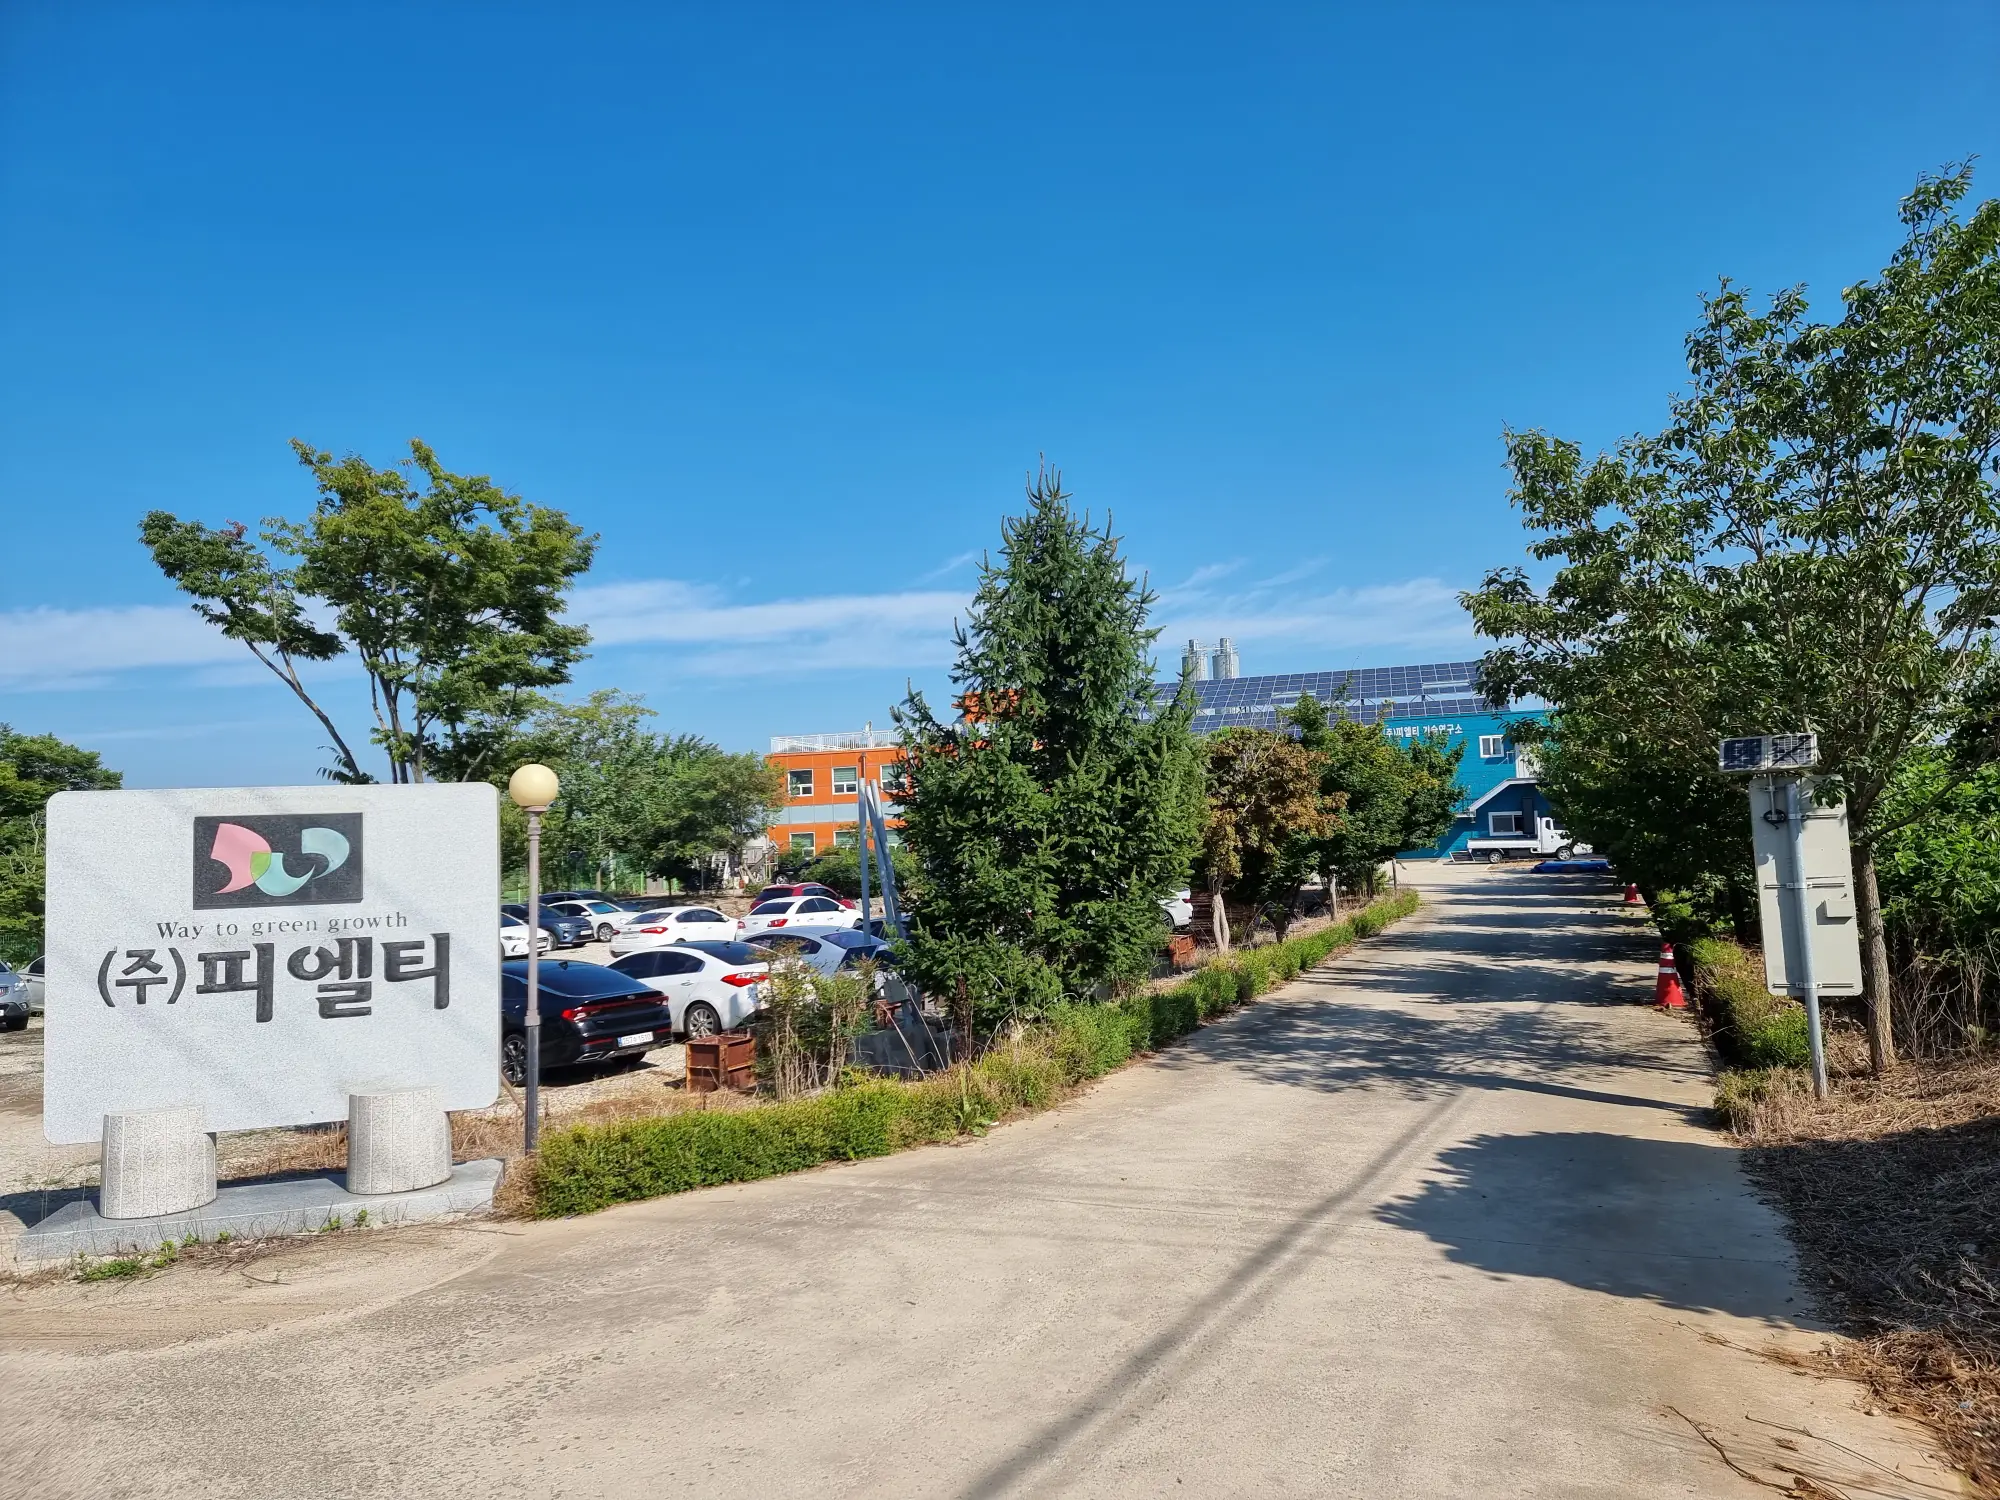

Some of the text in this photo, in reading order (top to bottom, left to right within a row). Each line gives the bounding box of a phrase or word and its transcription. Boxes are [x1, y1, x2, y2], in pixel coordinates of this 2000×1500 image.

[1383, 725, 1419, 738] (주)피엘티
[156, 911, 408, 940] Way to green growth
[97, 933, 450, 1023] (주)피엘티
